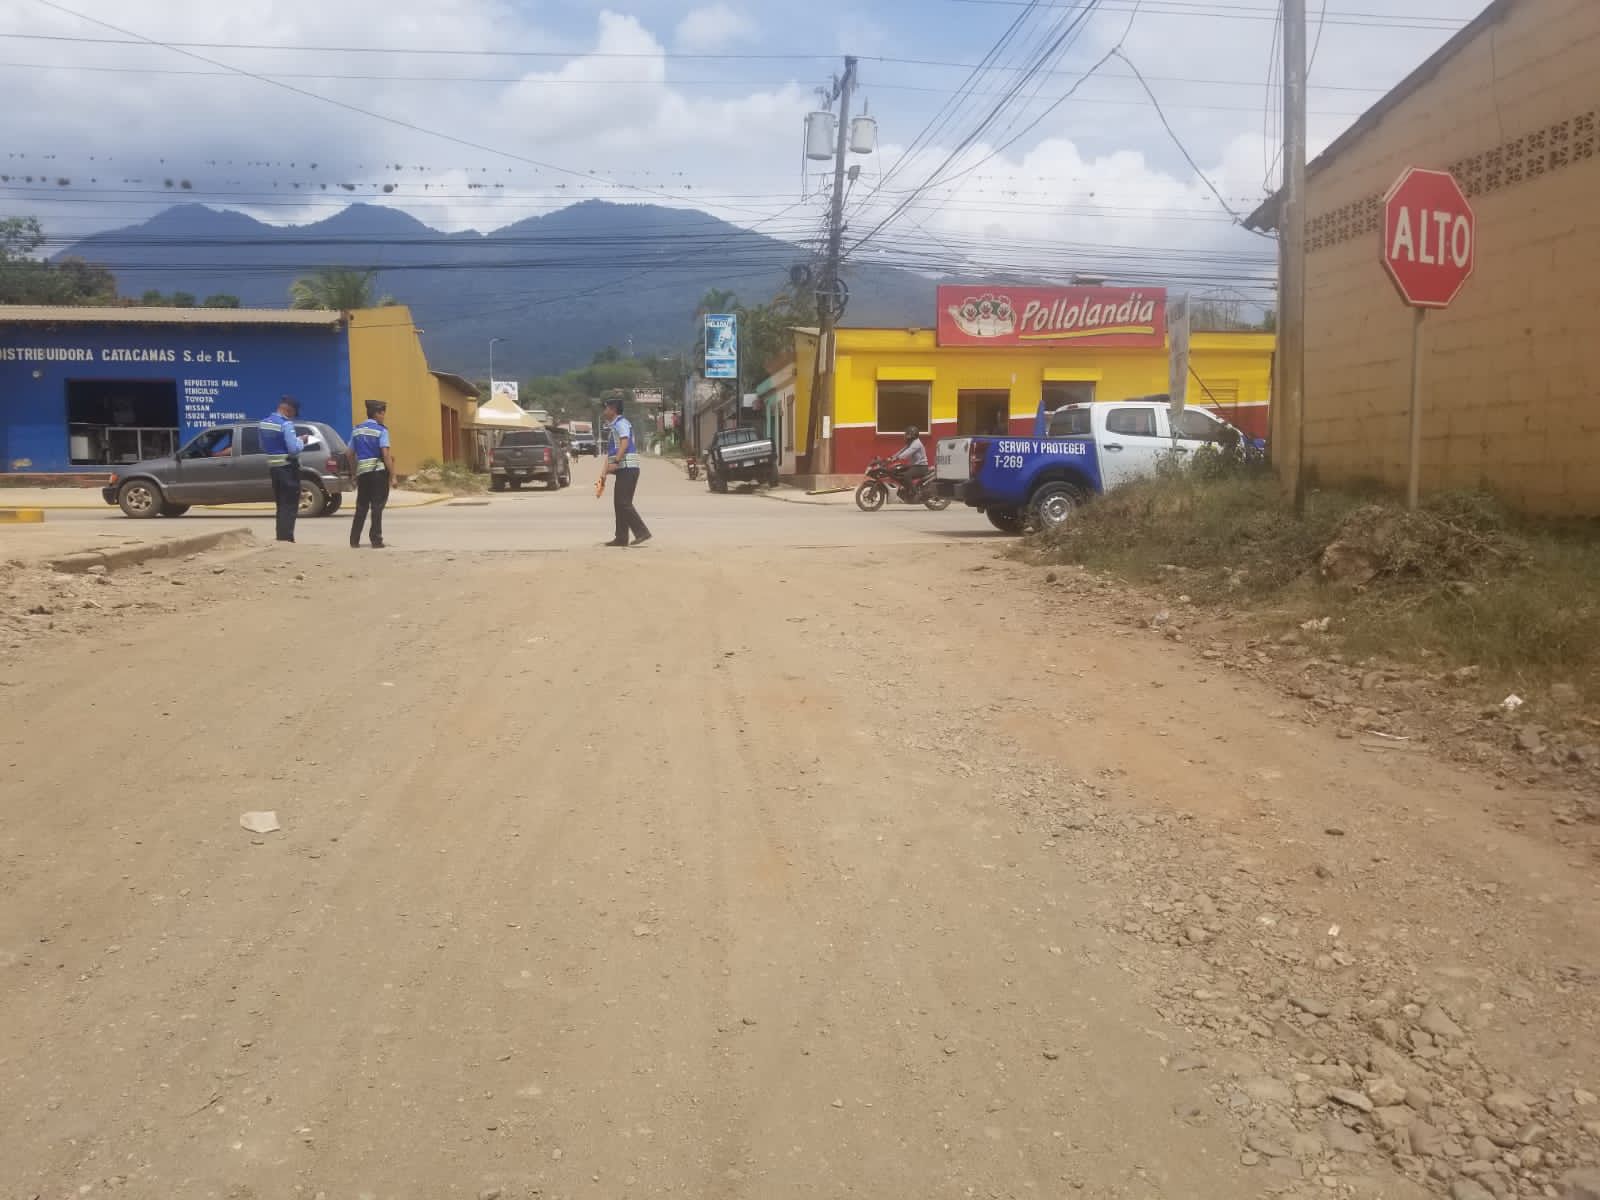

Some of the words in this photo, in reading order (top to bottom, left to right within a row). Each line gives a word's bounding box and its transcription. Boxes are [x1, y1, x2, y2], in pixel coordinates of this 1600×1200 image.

[1391, 206, 1471, 268] ALTO
[1020, 291, 1156, 331] Pollolandia
[0, 347, 94, 361] ISTRIBUIDORA
[102, 348, 176, 362] CATACAMAS
[216, 351, 241, 363] R.L.
[184, 379, 219, 387] REPUESTOS
[221, 379, 239, 387] PARA
[185, 395, 214, 403] TOYOTA
[185, 404, 210, 412] NISSAN
[193, 420, 217, 428] OTROS
[998, 440, 1031, 453] SERVIR
[1032, 441, 1039, 453] Y
[1040, 442, 1086, 455] PROTEGER
[994, 455, 1023, 468] T-269
